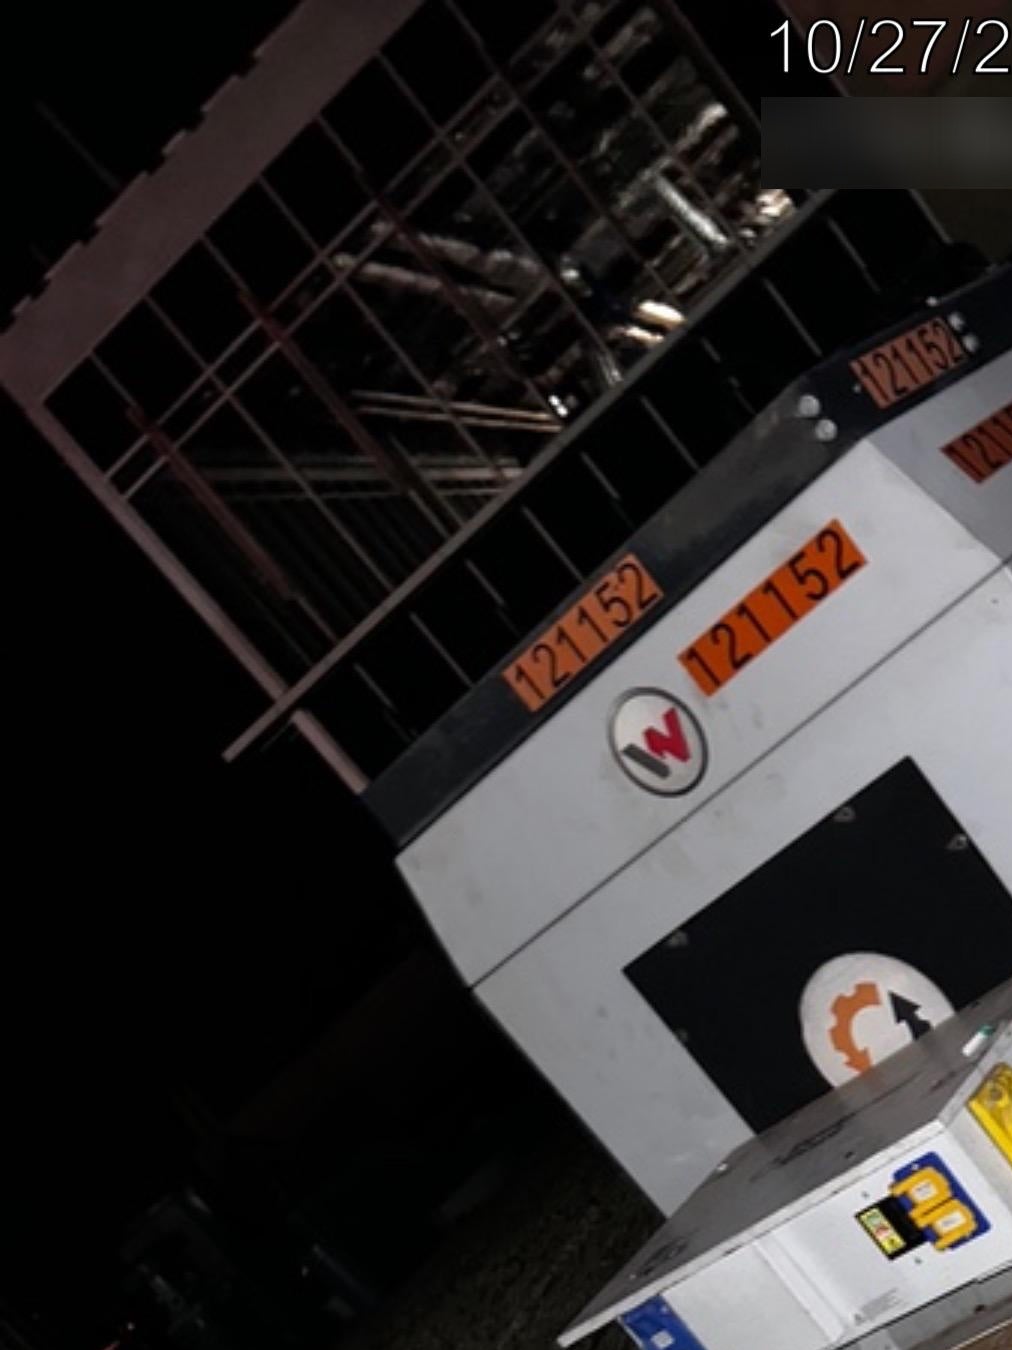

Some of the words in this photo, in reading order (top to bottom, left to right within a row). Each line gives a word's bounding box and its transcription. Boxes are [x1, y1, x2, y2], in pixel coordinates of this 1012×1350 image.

[856, 319, 966, 403] 121152
[514, 561, 659, 701] 121152
[686, 528, 861, 690] 121152
